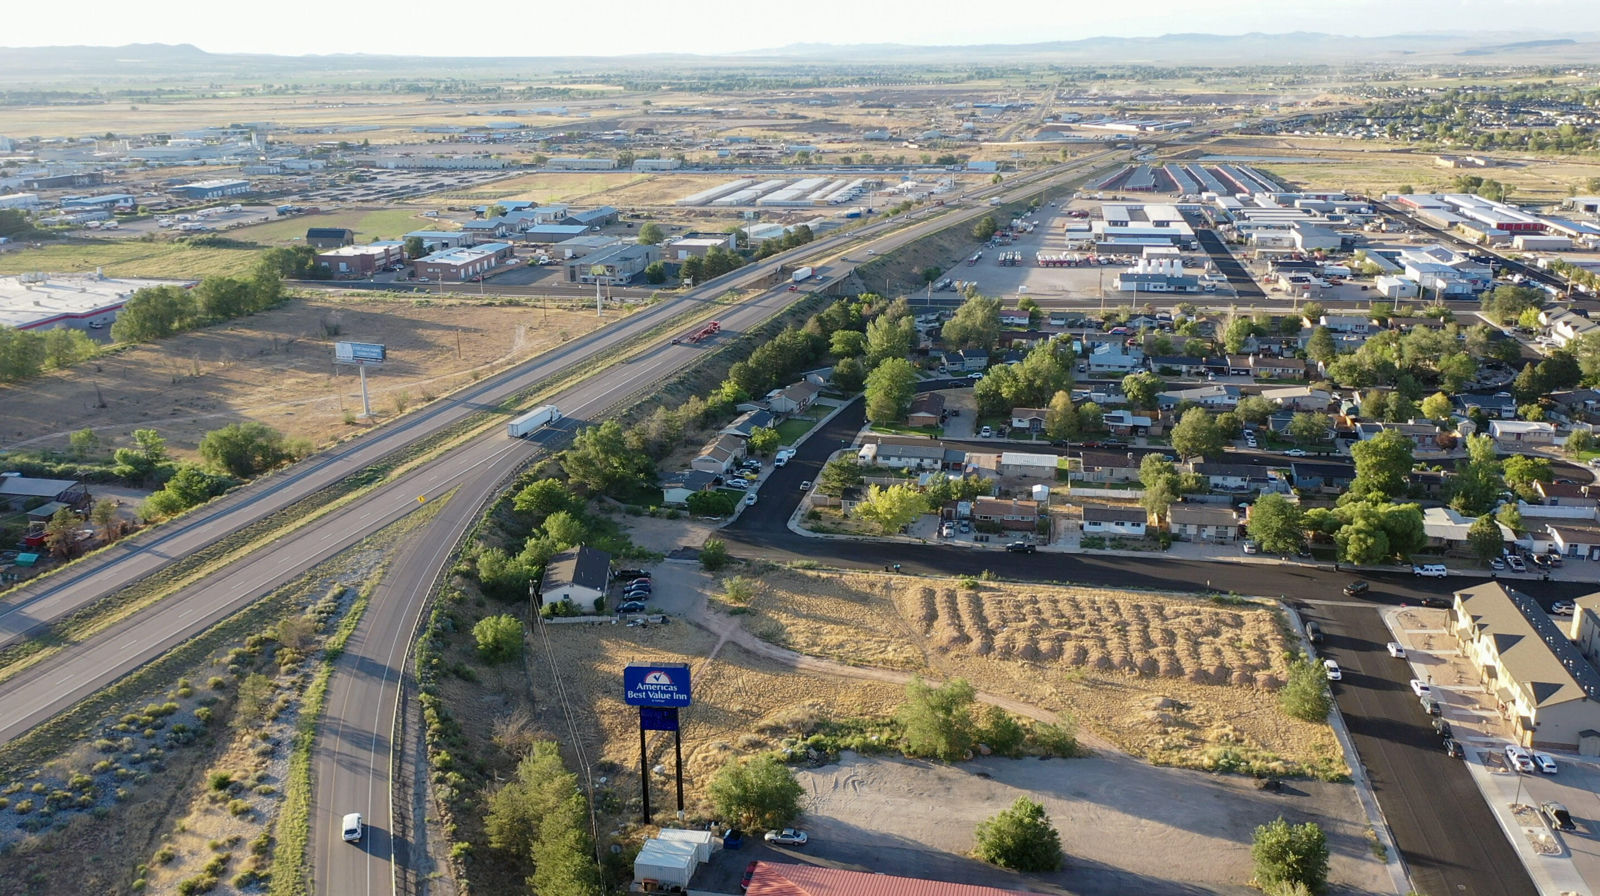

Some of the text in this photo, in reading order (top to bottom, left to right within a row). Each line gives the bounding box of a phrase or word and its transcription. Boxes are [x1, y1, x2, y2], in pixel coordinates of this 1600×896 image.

[636, 682, 678, 691] Americas
[627, 690, 687, 700] Best Value Inn
